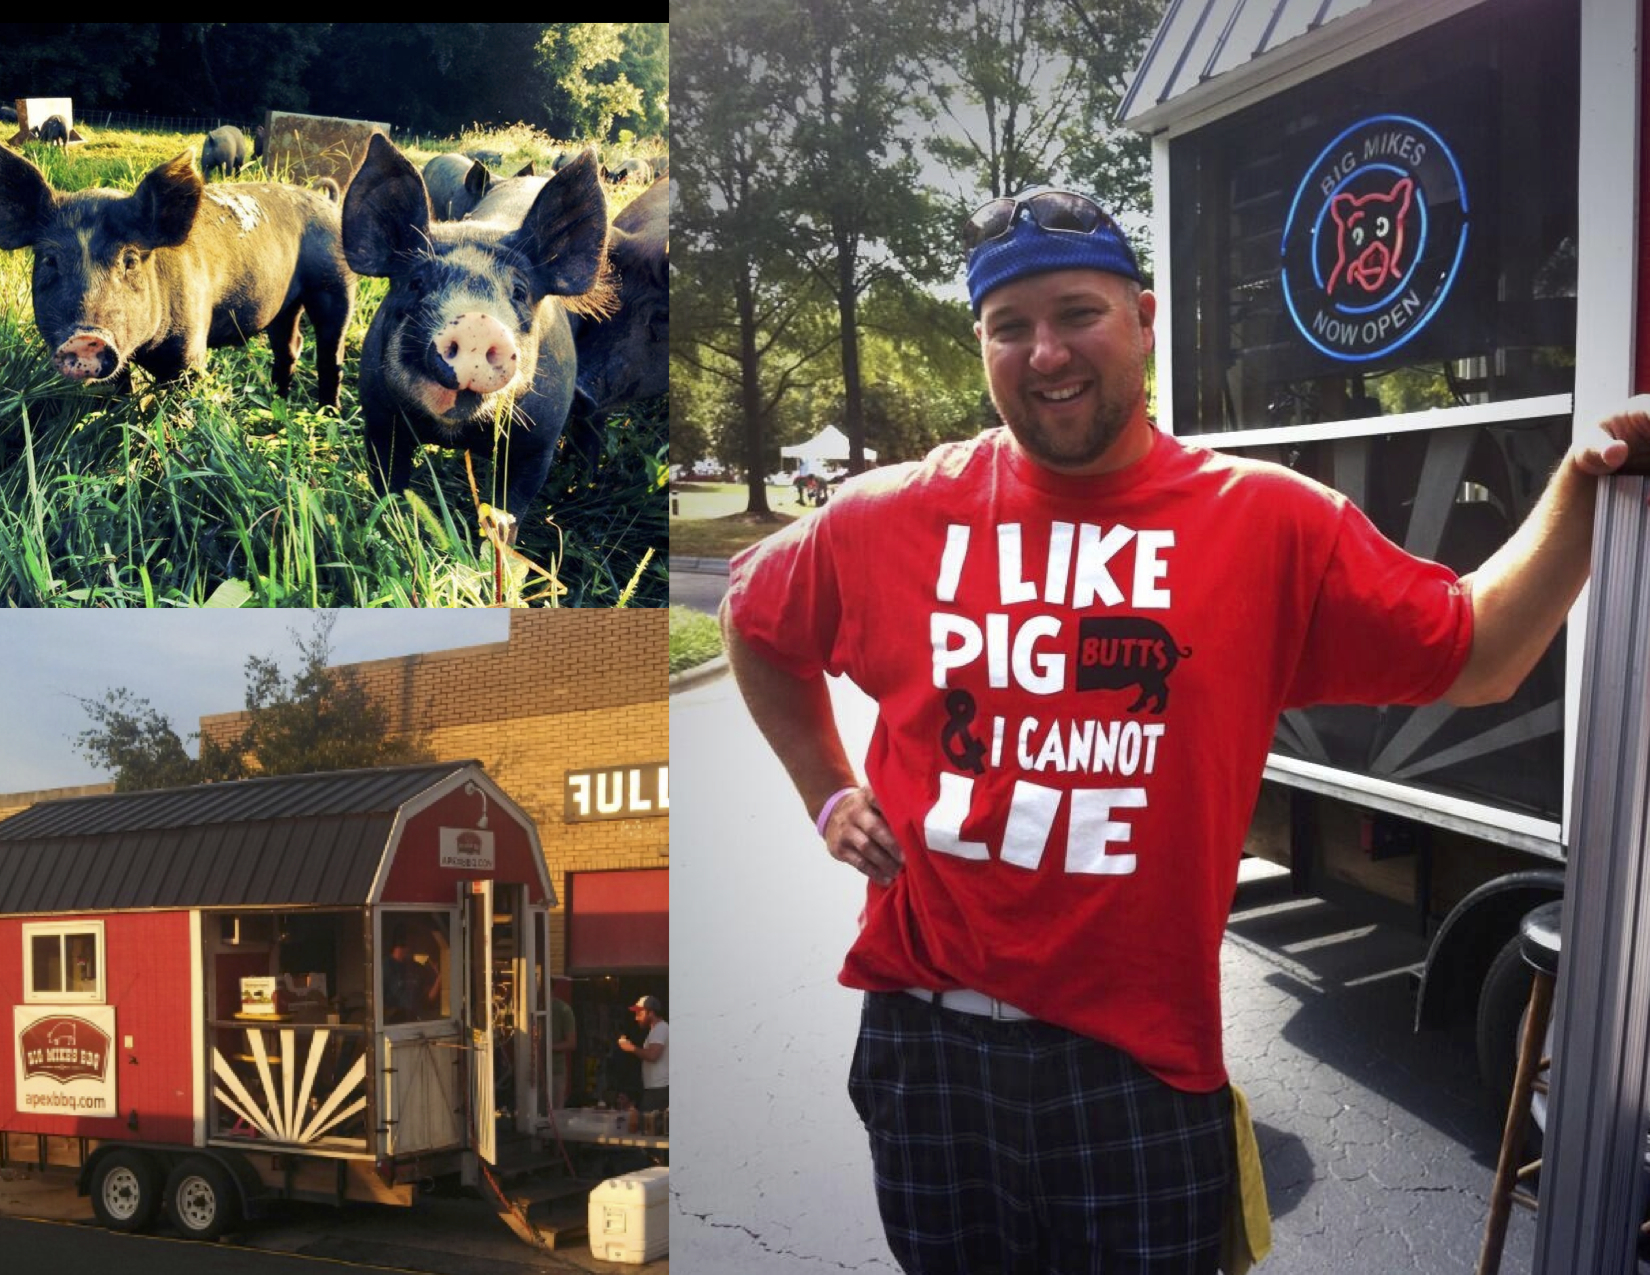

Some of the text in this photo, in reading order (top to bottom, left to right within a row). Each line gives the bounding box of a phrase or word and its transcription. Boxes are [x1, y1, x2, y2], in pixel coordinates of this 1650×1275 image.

[1320, 131, 1425, 196] BIG MIKES
[1312, 290, 1421, 345] NOW OPEN
[936, 521, 1175, 609] I LIKE
[930, 612, 1167, 695] PIG BUTTS
[941, 688, 1166, 777] & I CANNOT
[924, 771, 1148, 875] LIE
[25, 1090, 106, 1111] apexbbq.com
